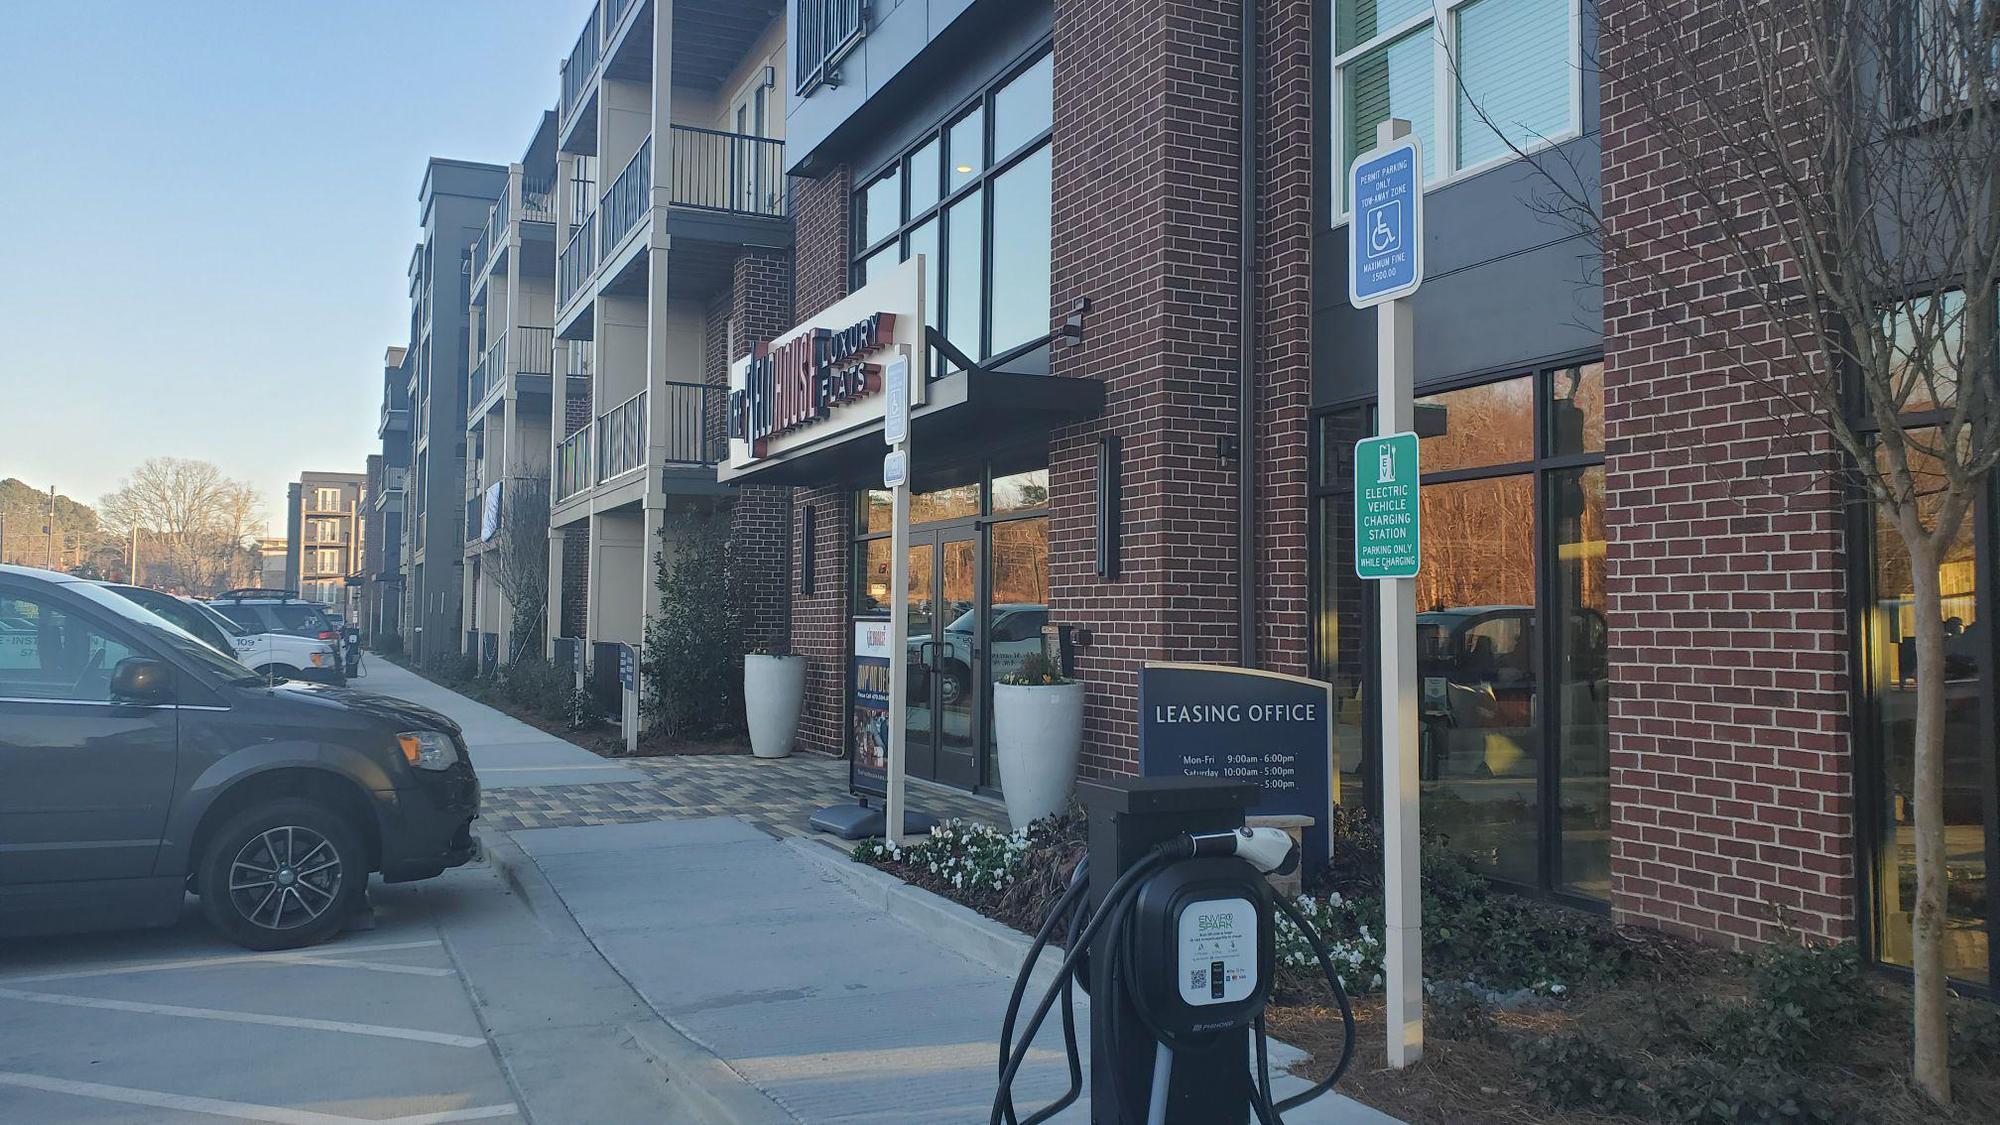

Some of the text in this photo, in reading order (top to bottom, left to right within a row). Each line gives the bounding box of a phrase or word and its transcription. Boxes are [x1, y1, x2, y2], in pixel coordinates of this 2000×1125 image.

[1360, 159, 1408, 186] PERMIT PARKING
[1375, 177, 1391, 191] ONLY
[1361, 183, 1407, 208] TOW-AWAY ZONE
[1363, 251, 1406, 273] MAXIMUM FINE
[821, 311, 881, 369] LUXURY
[821, 362, 866, 408] FLATS
[745, 328, 818, 458] FIELDHOUSE
[1365, 484, 1409, 500] ELECTRIC
[1367, 499, 1407, 513] VEHICLE
[1364, 512, 1411, 527] CHARGING
[1368, 527, 1407, 541] STATION
[1362, 543, 1413, 556] PARKING ONLY
[1360, 555, 1416, 567] WHILE CHARGING
[236, 638, 255, 646] 109
[1155, 704, 1316, 723] LEASING OFFICE
[1183, 754, 1215, 765] Mon-Fri
[1227, 754, 1258, 764] 9:00am
[1264, 753, 1295, 765] 6:00pm
[1224, 767, 1258, 777] 10:00am
[1264, 766, 1295, 778] 5:00pm
[1265, 779, 1295, 791] 5:00pm
[1199, 921, 1233, 931] SPARK
